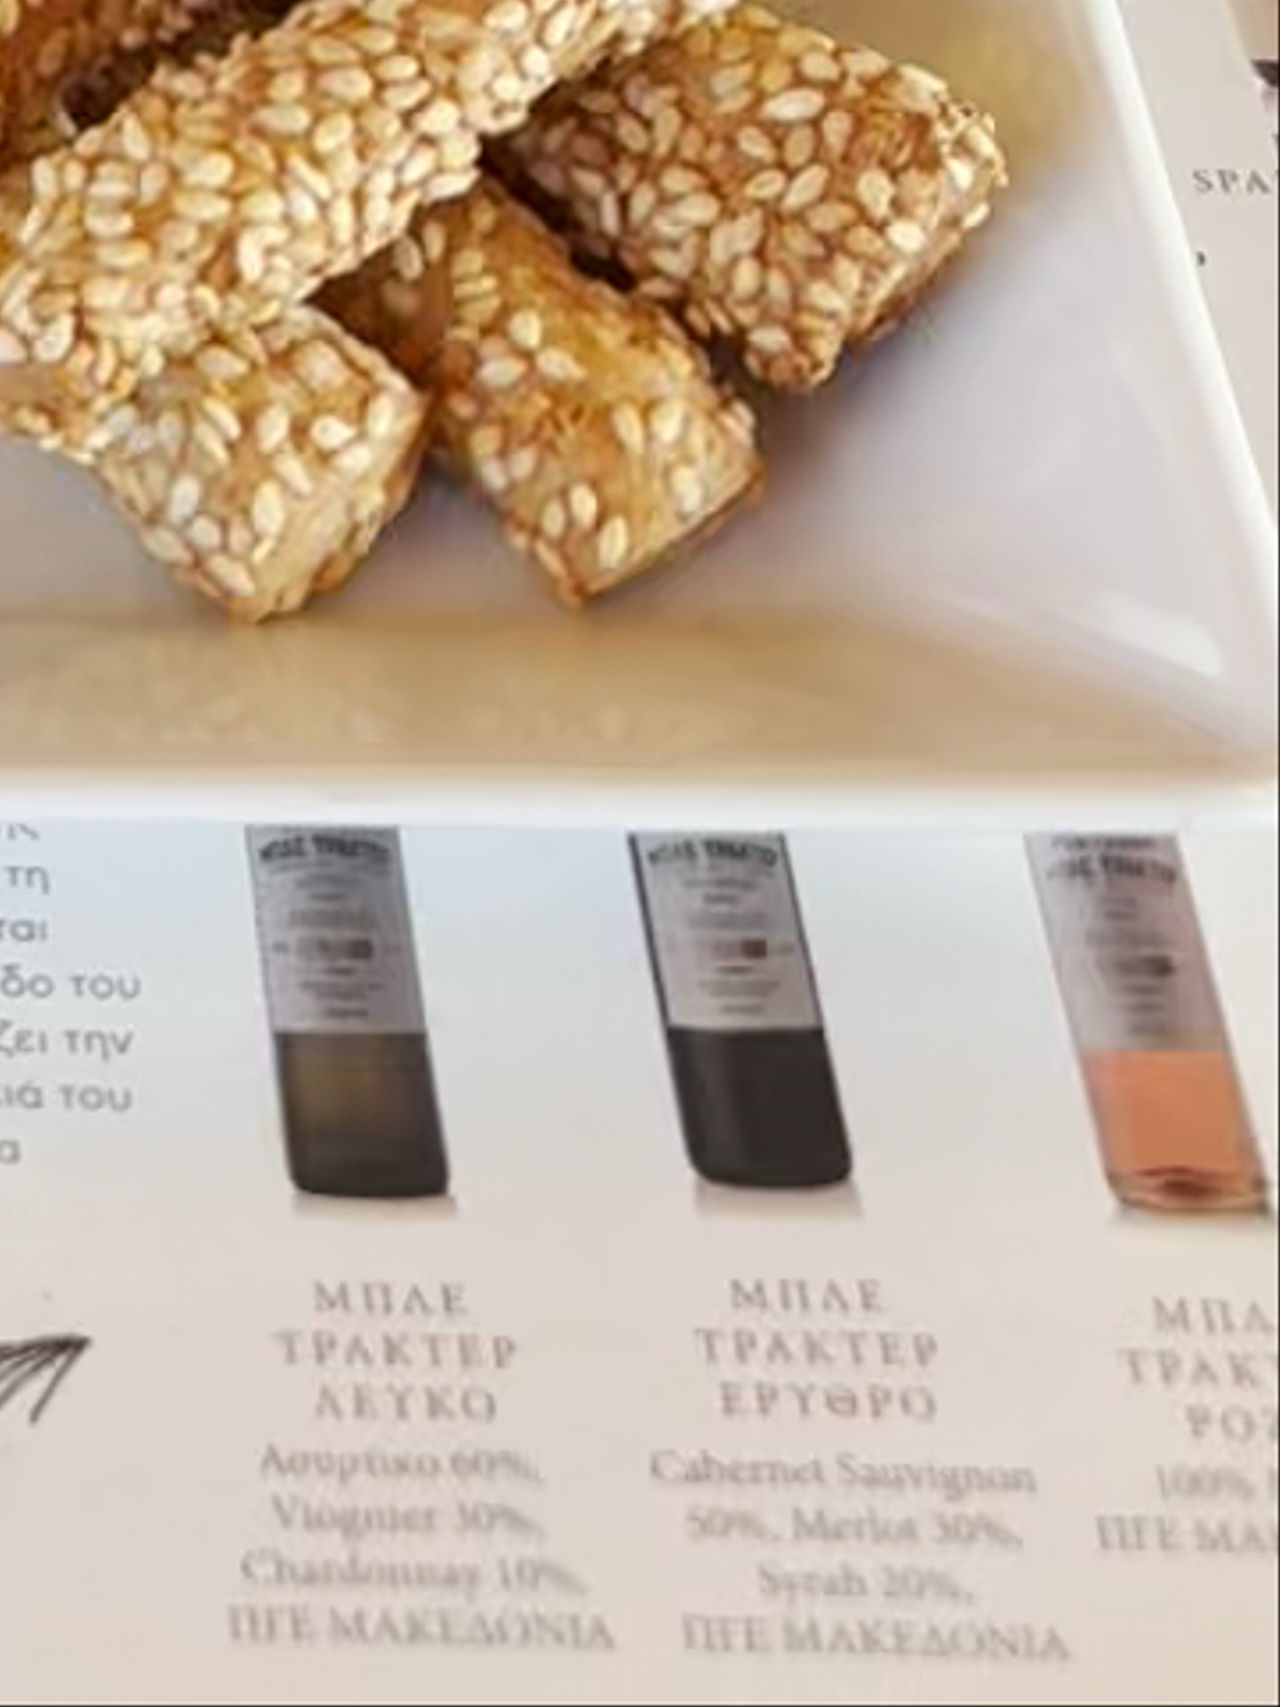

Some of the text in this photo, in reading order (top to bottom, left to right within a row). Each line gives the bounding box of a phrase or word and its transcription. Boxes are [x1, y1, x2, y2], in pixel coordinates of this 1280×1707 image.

[2, 861, 51, 895] τη
[68, 972, 143, 1001] του
[61, 1026, 134, 1062] την
[57, 1082, 134, 1113] του
[311, 1280, 468, 1318] ΜΠΛΕ
[728, 1277, 886, 1315] ΜΠΛΕ
[275, 1330, 518, 1371] ΤΡΑΚΤΕΡ
[692, 1327, 940, 1370] ΤΡΑΚΤΕΡ
[311, 1383, 501, 1424] ΛΕΥΚΟ
[718, 1379, 939, 1422] ΕΡΥΘΡΟ
[649, 1446, 1037, 1502] Cabernet Sauvignon
[271, 1494, 438, 1537] Viognier
[790, 1505, 919, 1549] Merlot
[756, 1559, 869, 1605] Syrah
[228, 1606, 616, 1650] ΠΓΕ ΜΑΚΕΔΟΝΙΑ
[679, 1611, 1073, 1666] ΠΓΕ ΜΑΚΕΔΟΝΙΑ
